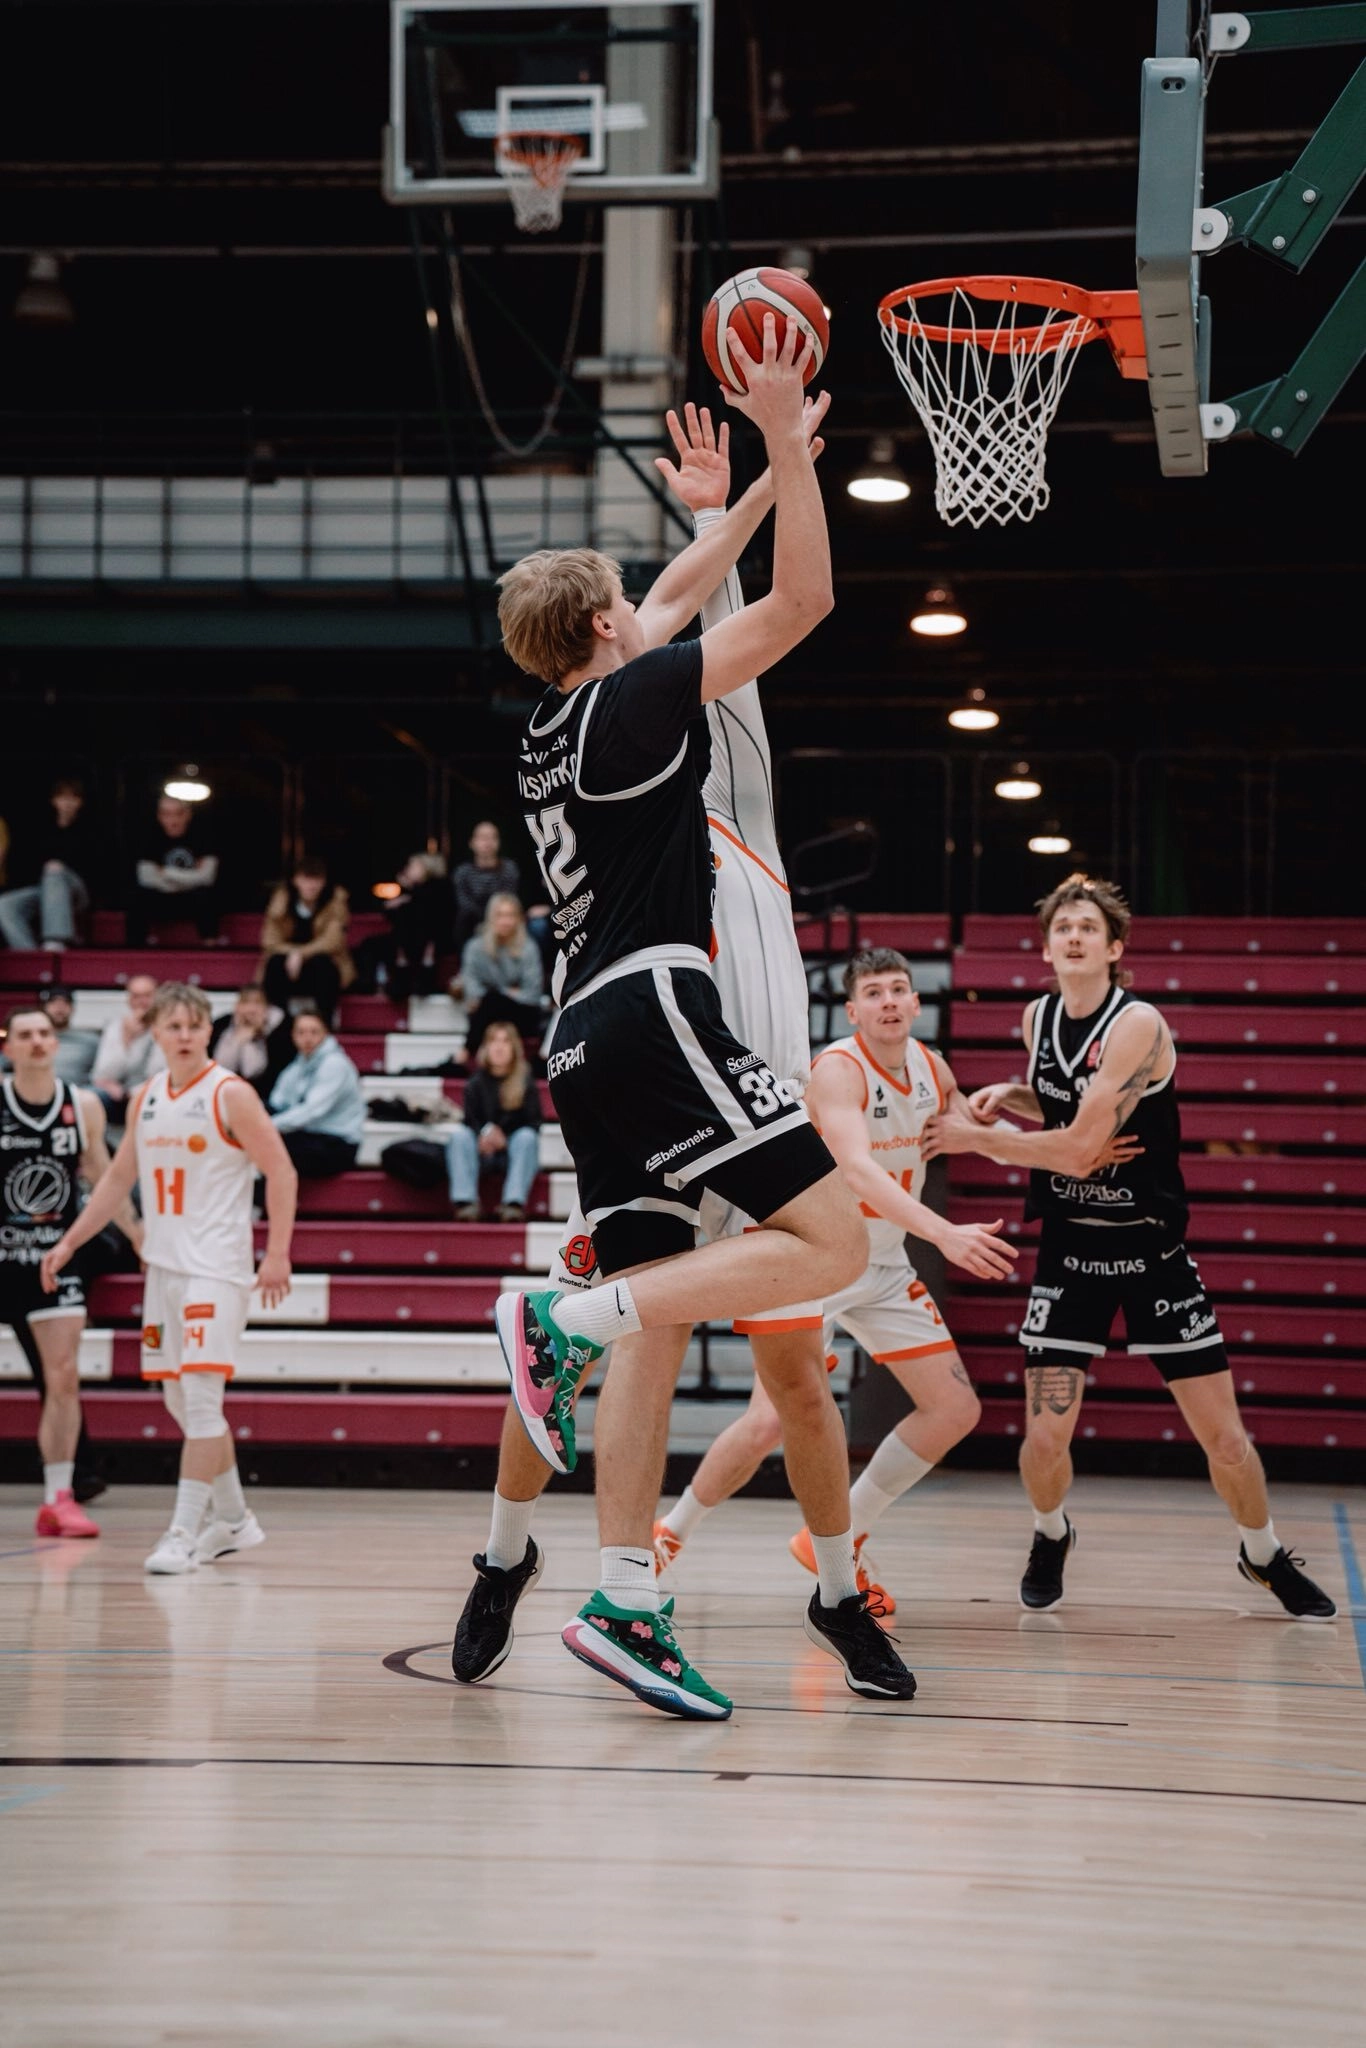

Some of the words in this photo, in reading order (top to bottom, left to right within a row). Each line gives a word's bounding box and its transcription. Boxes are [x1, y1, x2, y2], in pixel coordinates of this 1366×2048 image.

[738, 1066, 796, 1118] 32
[51, 1126, 78, 1156] 21
[660, 1126, 715, 1163] betoneks
[1081, 1259, 1146, 1276] UTILITAS
